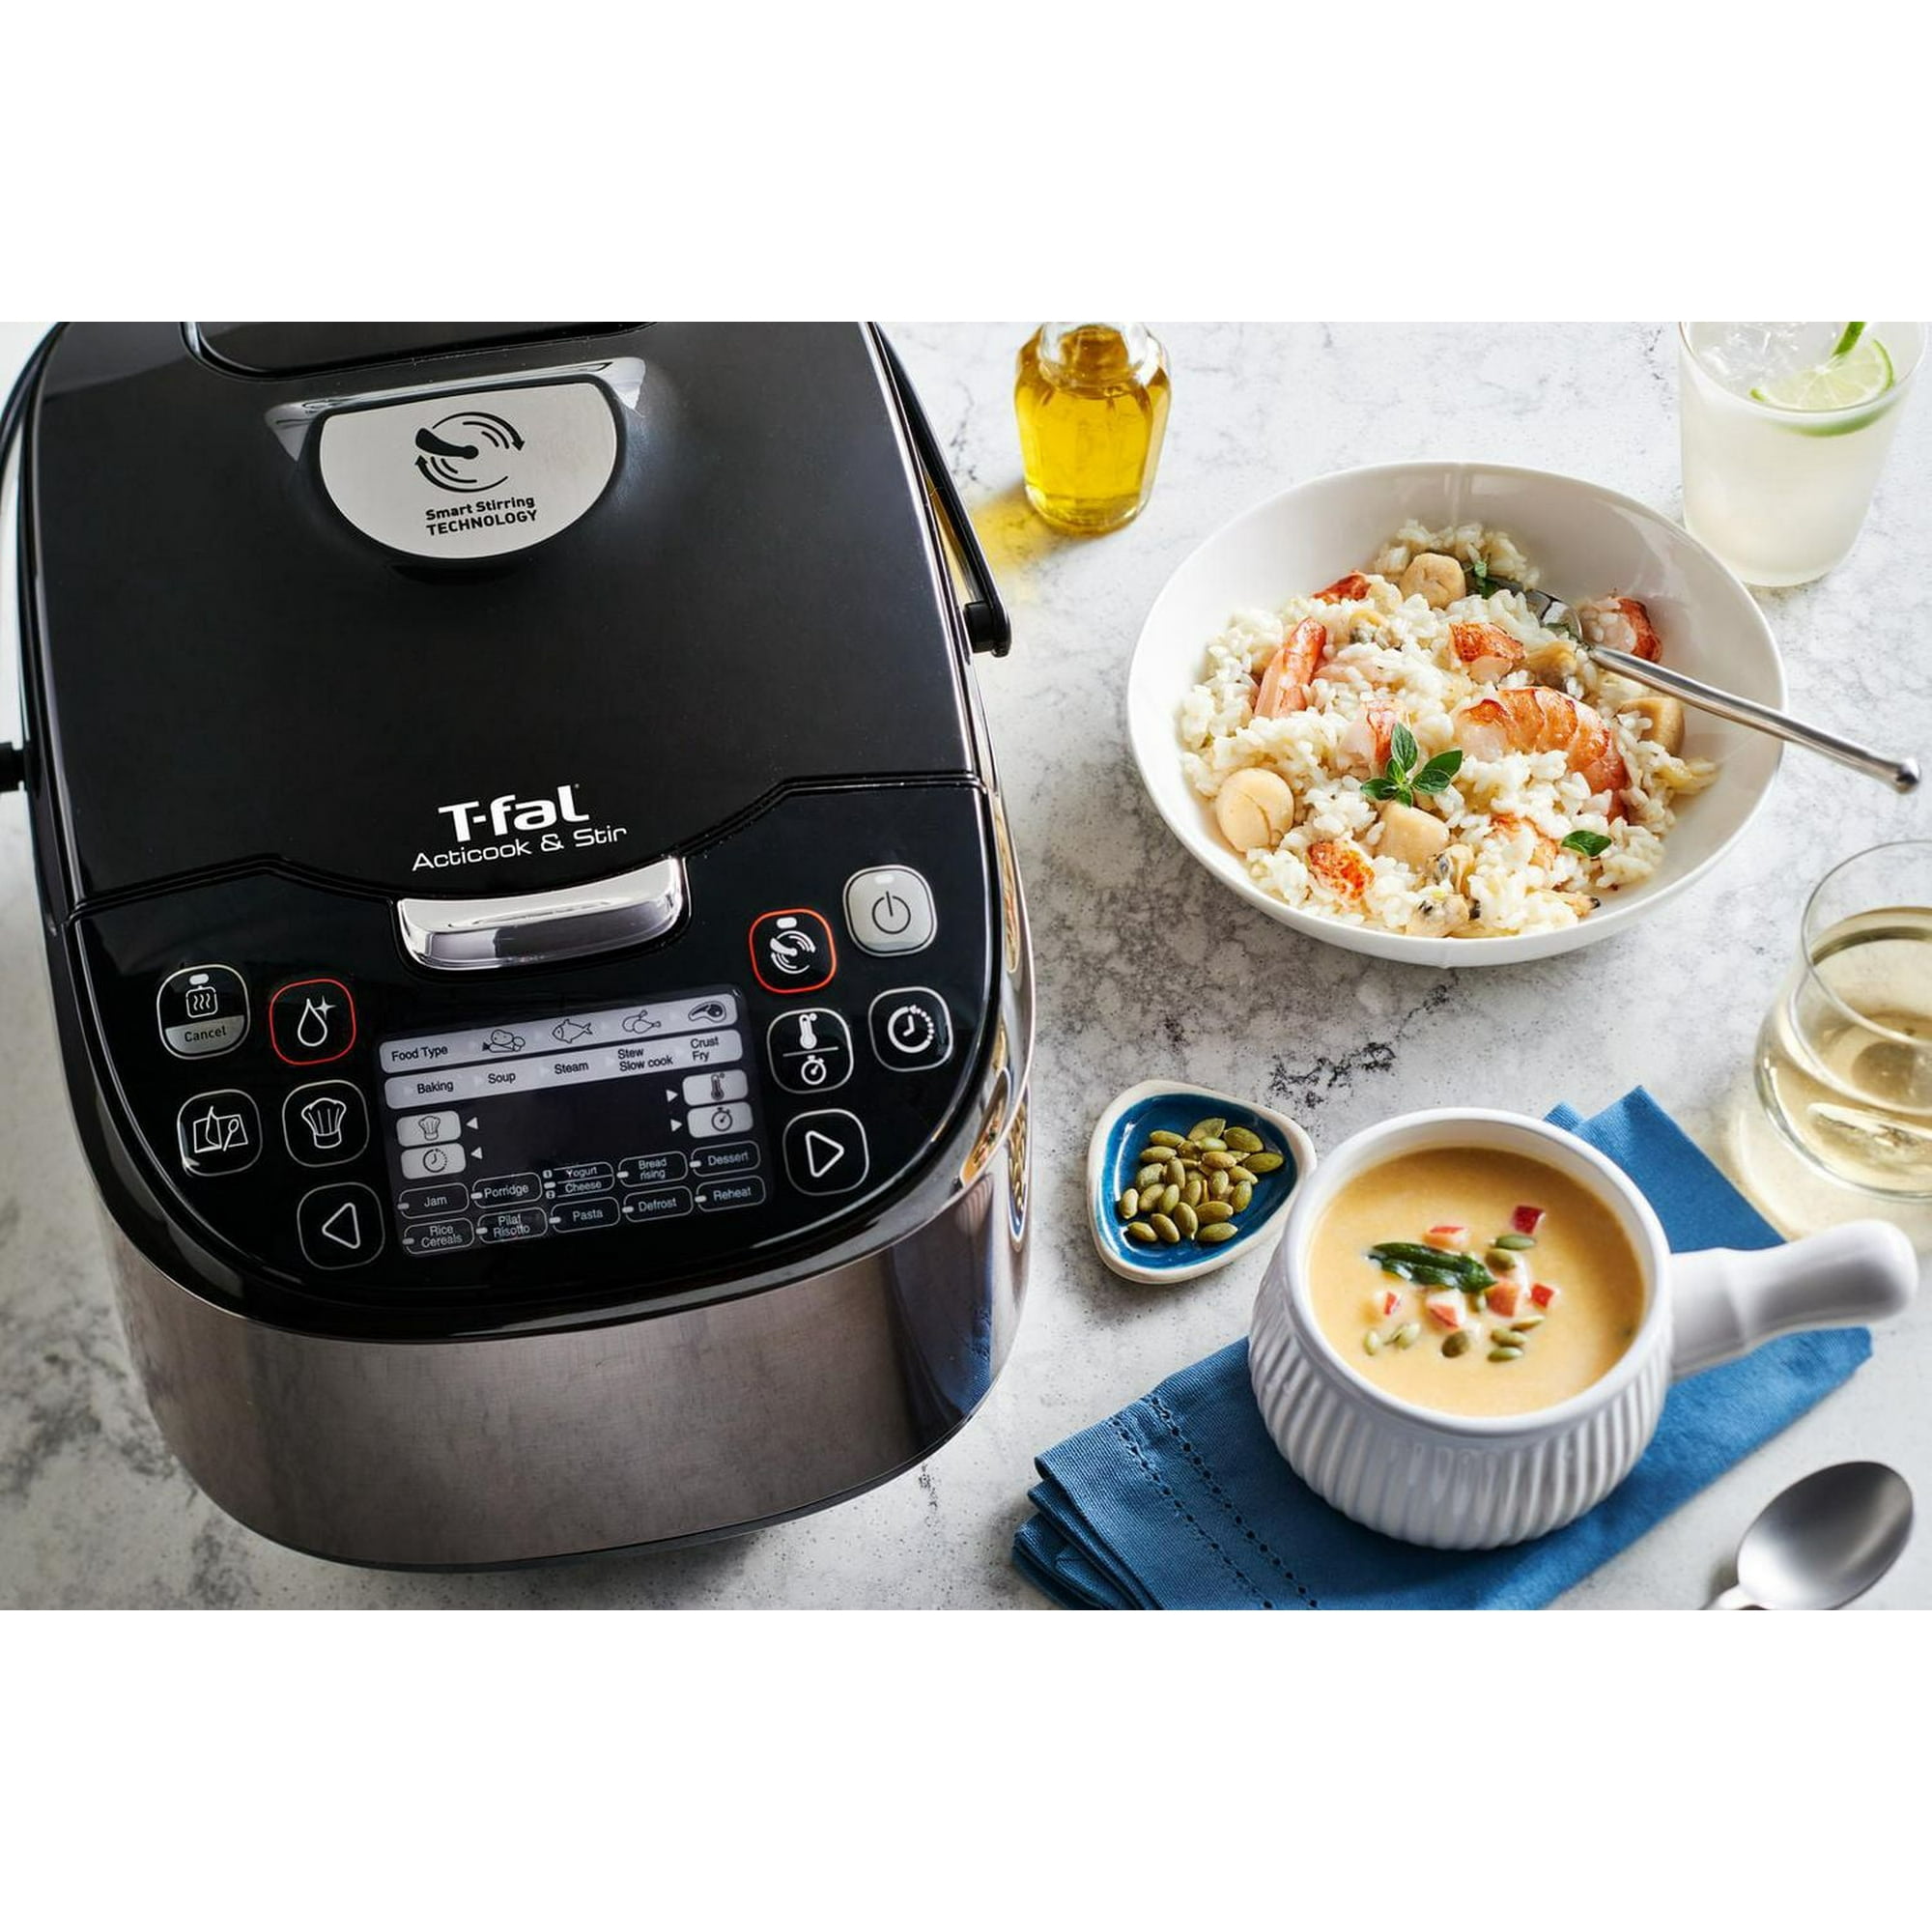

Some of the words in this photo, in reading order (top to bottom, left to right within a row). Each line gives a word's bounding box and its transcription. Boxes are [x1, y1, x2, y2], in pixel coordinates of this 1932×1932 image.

[426, 503, 472, 521] Smart
[476, 497, 535, 512] Stirring
[426, 510, 537, 536] TECHNOLOGY
[438, 784, 590, 842] T-fal
[412, 839, 532, 871] Acticook
[541, 834, 564, 852] &
[573, 825, 627, 847] Stir
[185, 1026, 227, 1042] Cancel
[690, 1037, 719, 1049] Crust
[391, 1049, 418, 1062] Food
[420, 1045, 448, 1059] Type
[617, 1047, 644, 1060] Stew
[692, 1050, 709, 1062] Fry
[554, 1062, 589, 1074] Steam
[619, 1060, 646, 1072] Slow
[647, 1055, 673, 1068] cook
[488, 1072, 516, 1084] Soup
[417, 1081, 454, 1094] Baking
[639, 1157, 668, 1170] Bread
[708, 1151, 749, 1166] Dessert
[565, 1167, 597, 1179] Yogurt
[640, 1170, 666, 1180] rising
[484, 1183, 529, 1198] Porridge
[565, 1181, 602, 1193] Cheese
[713, 1186, 752, 1201] Reheat
[424, 1196, 447, 1208] Jam
[638, 1198, 677, 1212] Defrost
[572, 1209, 603, 1222] Pasta
[429, 1225, 453, 1236] Rice
[493, 1225, 530, 1237] Risotto
[421, 1234, 463, 1248] Cereals
